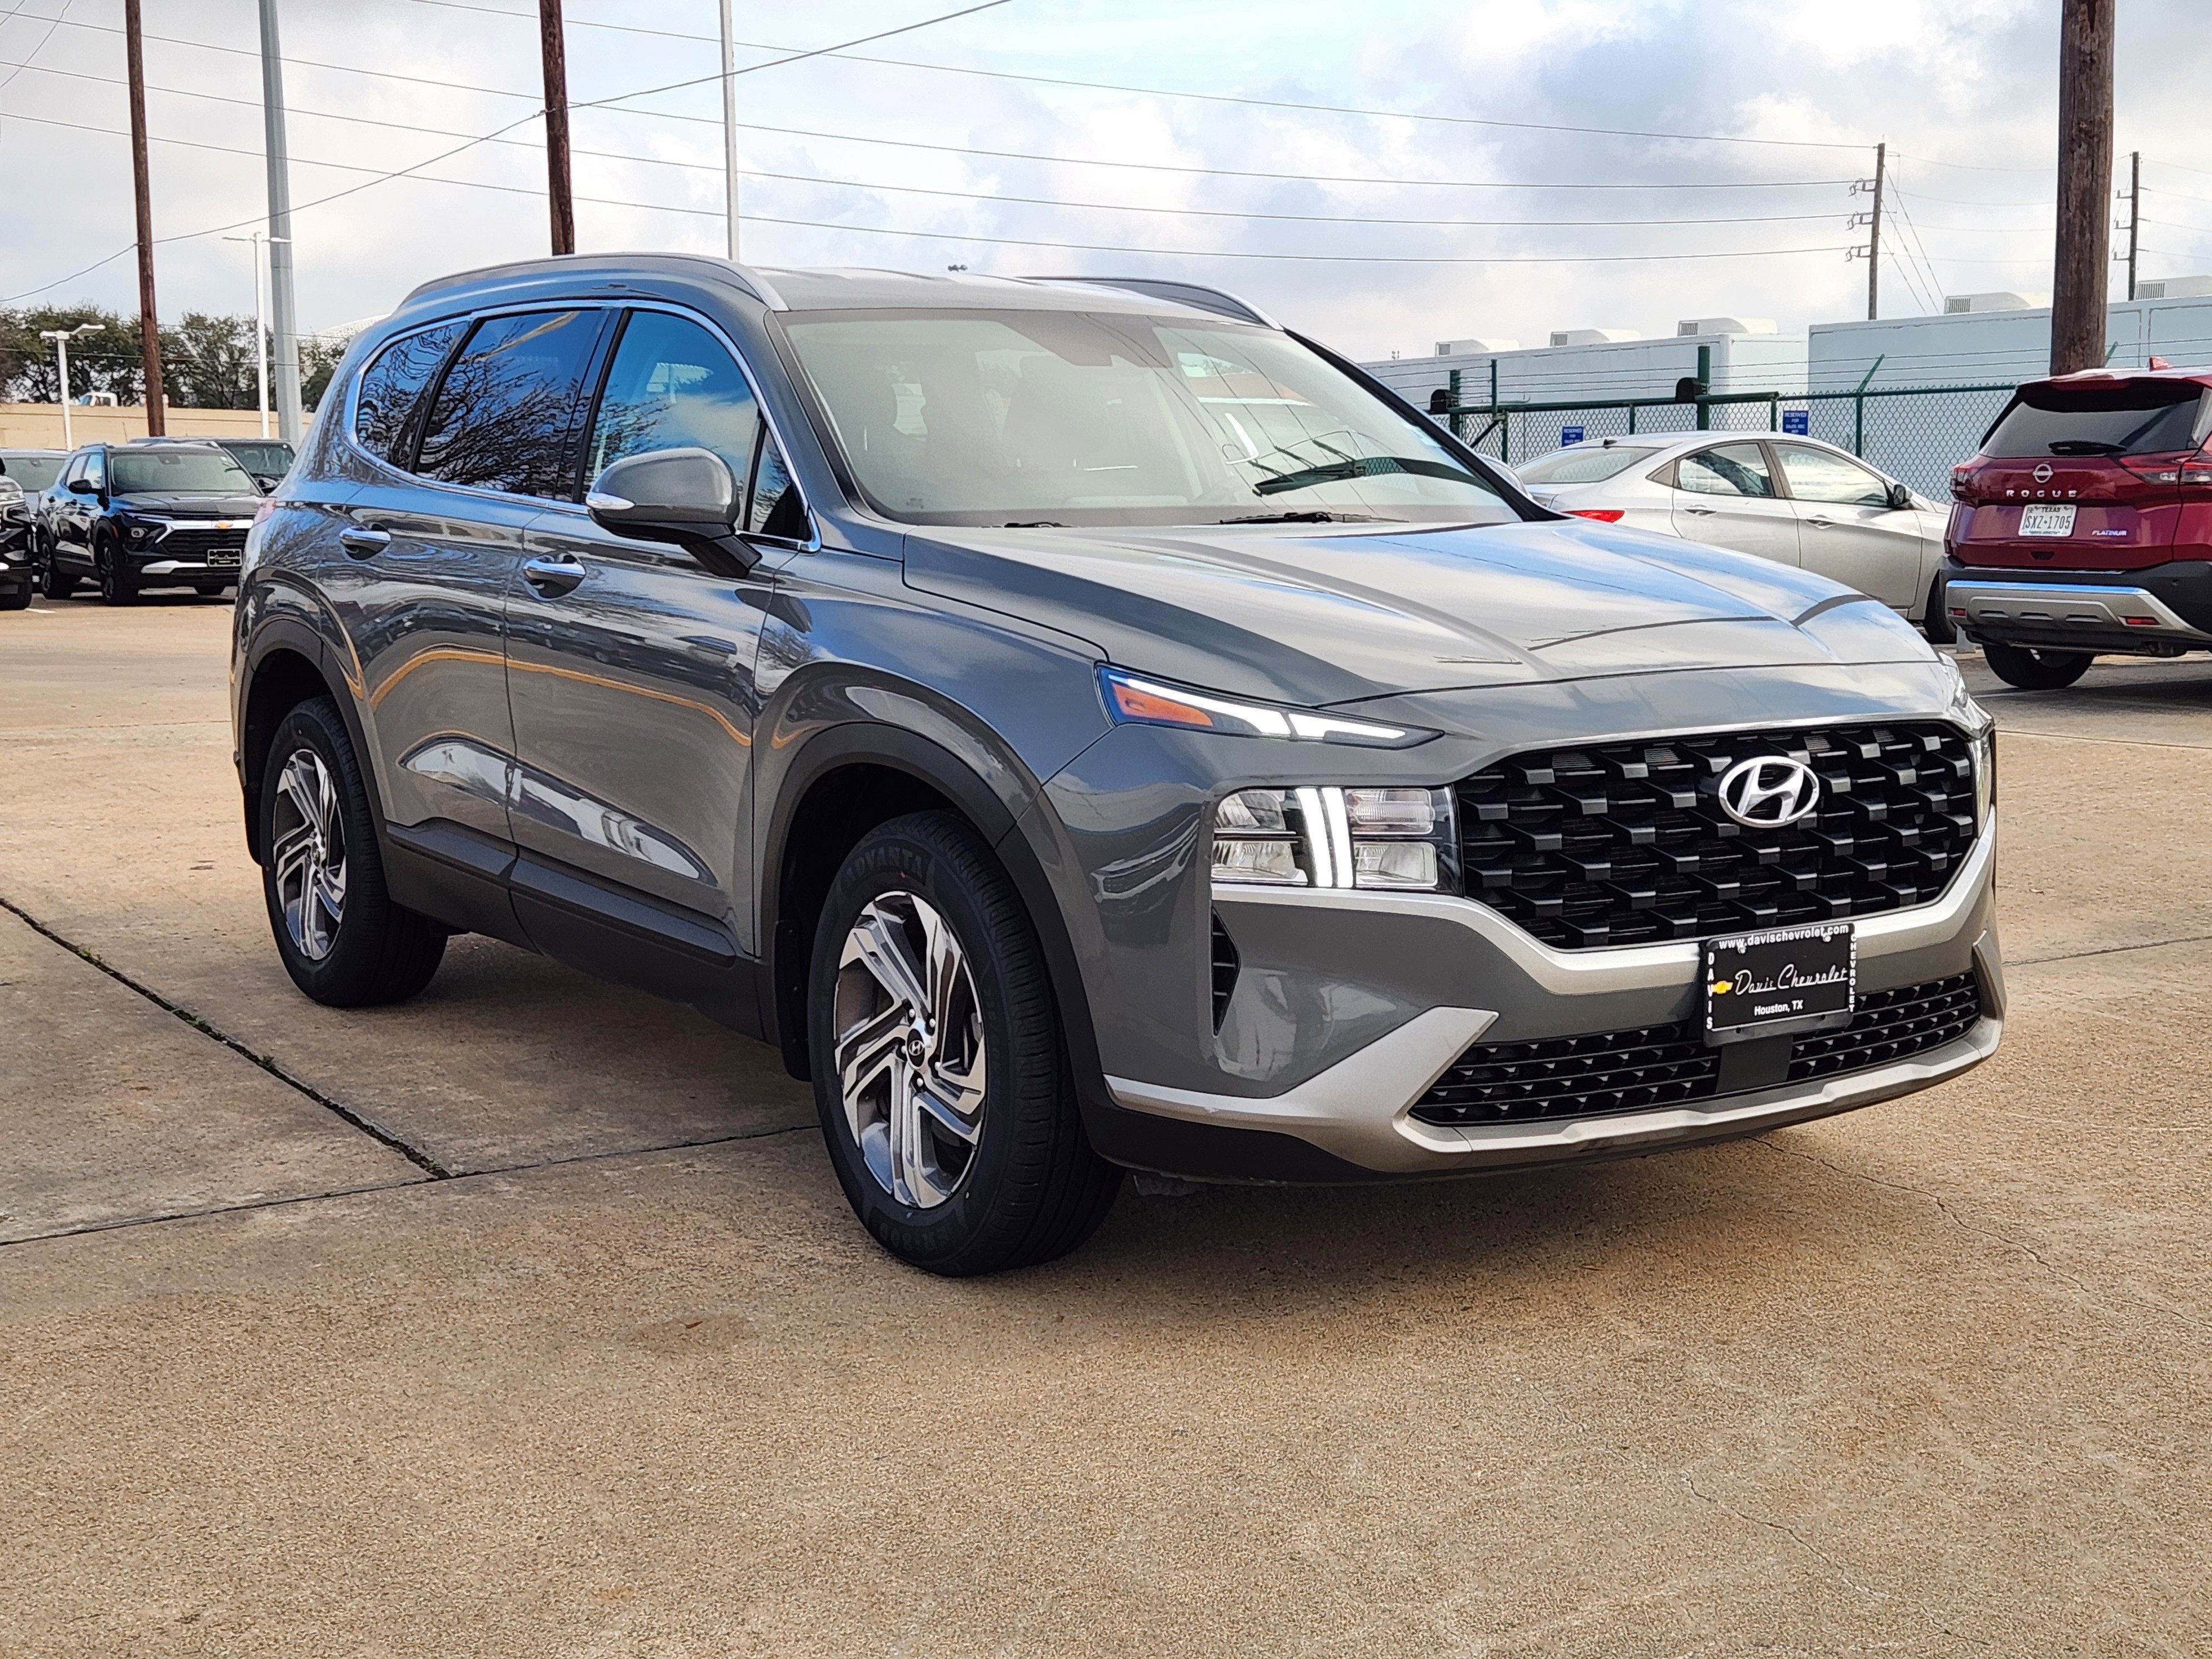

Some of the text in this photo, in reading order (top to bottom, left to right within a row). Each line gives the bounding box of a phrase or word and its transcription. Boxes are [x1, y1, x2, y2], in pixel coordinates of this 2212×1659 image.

[1719, 924, 1849, 950] www.davischevrolet.com
[1777, 963, 1848, 990] Chevrolet
[1848, 933, 1857, 1013] CHEVROLET
[1706, 952, 1715, 1030] DAVIS
[1754, 999, 1804, 1016] Houston, TX
